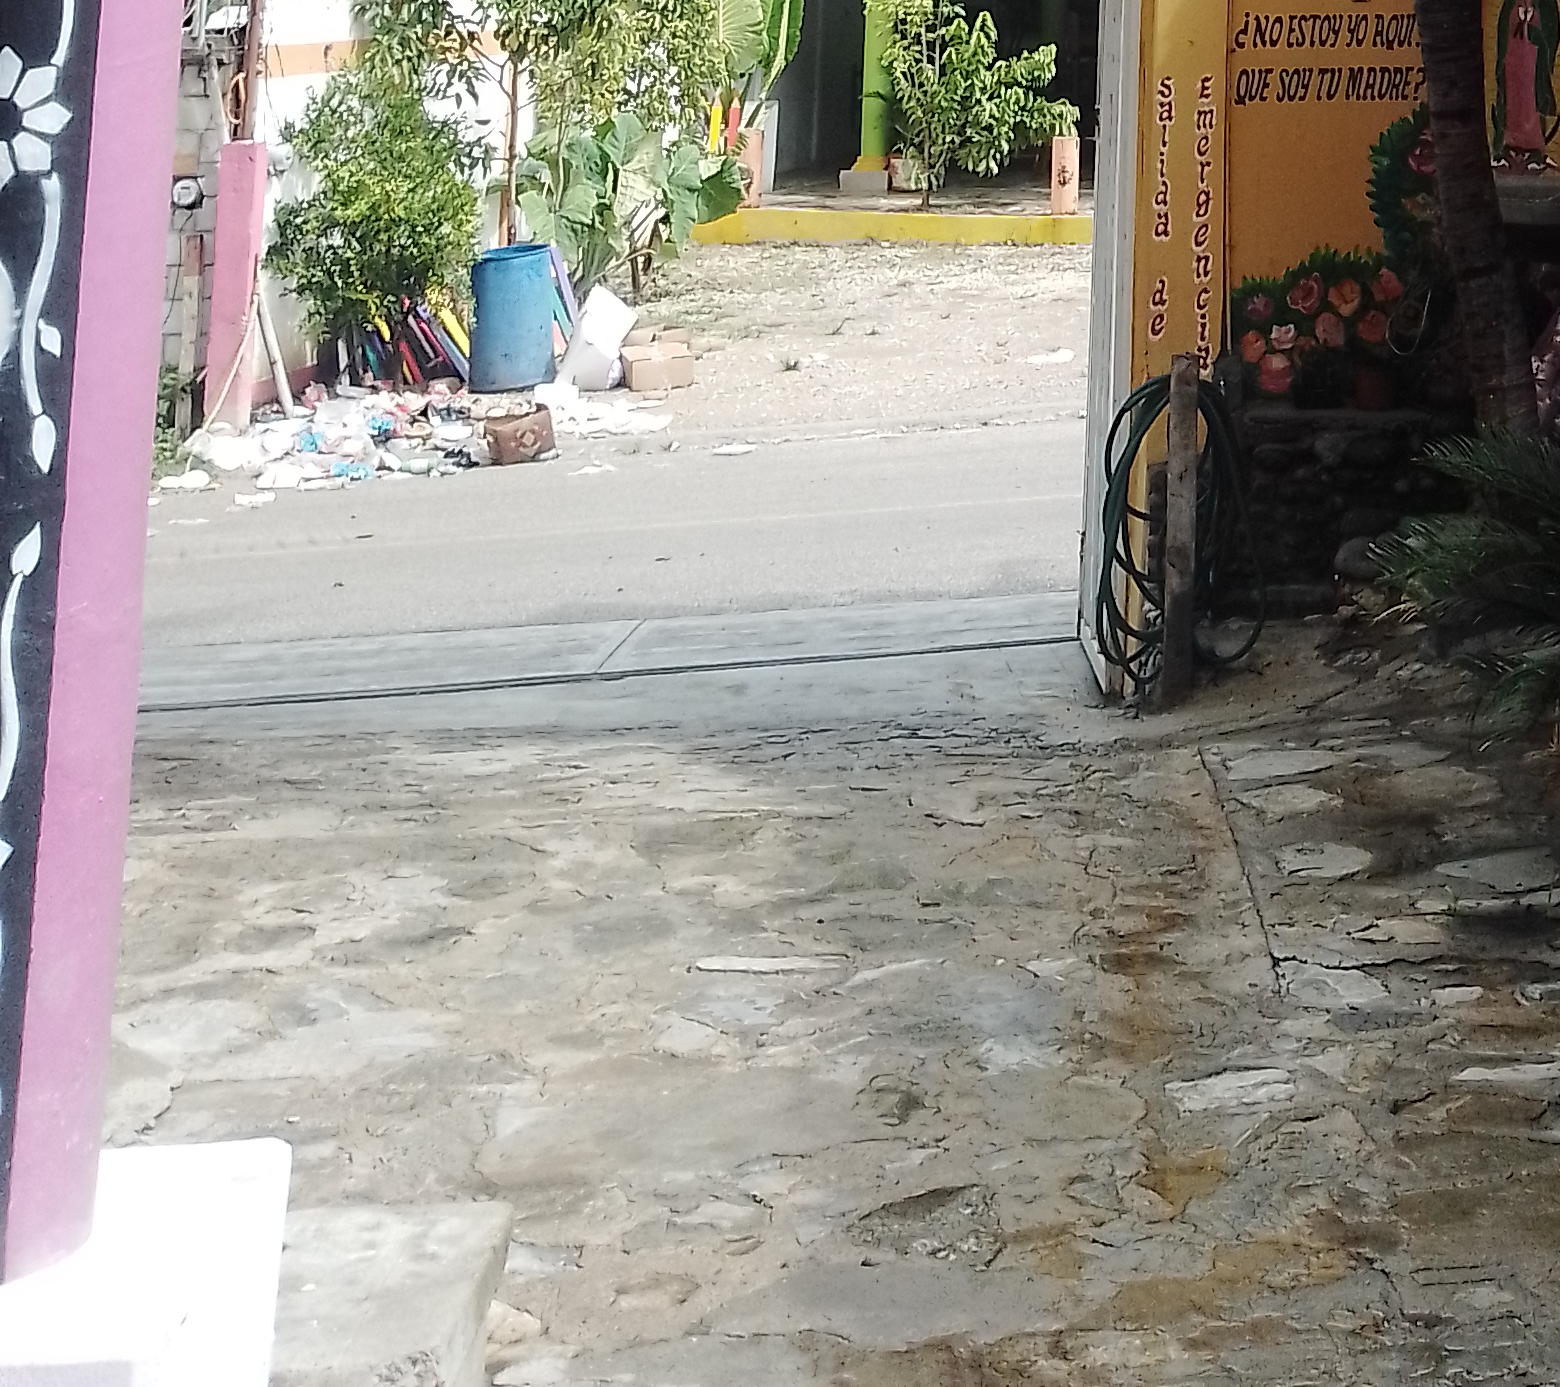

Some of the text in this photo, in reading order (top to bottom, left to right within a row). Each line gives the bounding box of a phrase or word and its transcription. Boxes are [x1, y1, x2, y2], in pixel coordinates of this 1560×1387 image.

[1233, 10, 1285, 50] ¿NO
[1286, 12, 1344, 49] ESTOY
[1345, 12, 1370, 49] YO
[1233, 65, 1426, 106] QUE SOY TU MADRE?
[1149, 277, 1168, 339] de
